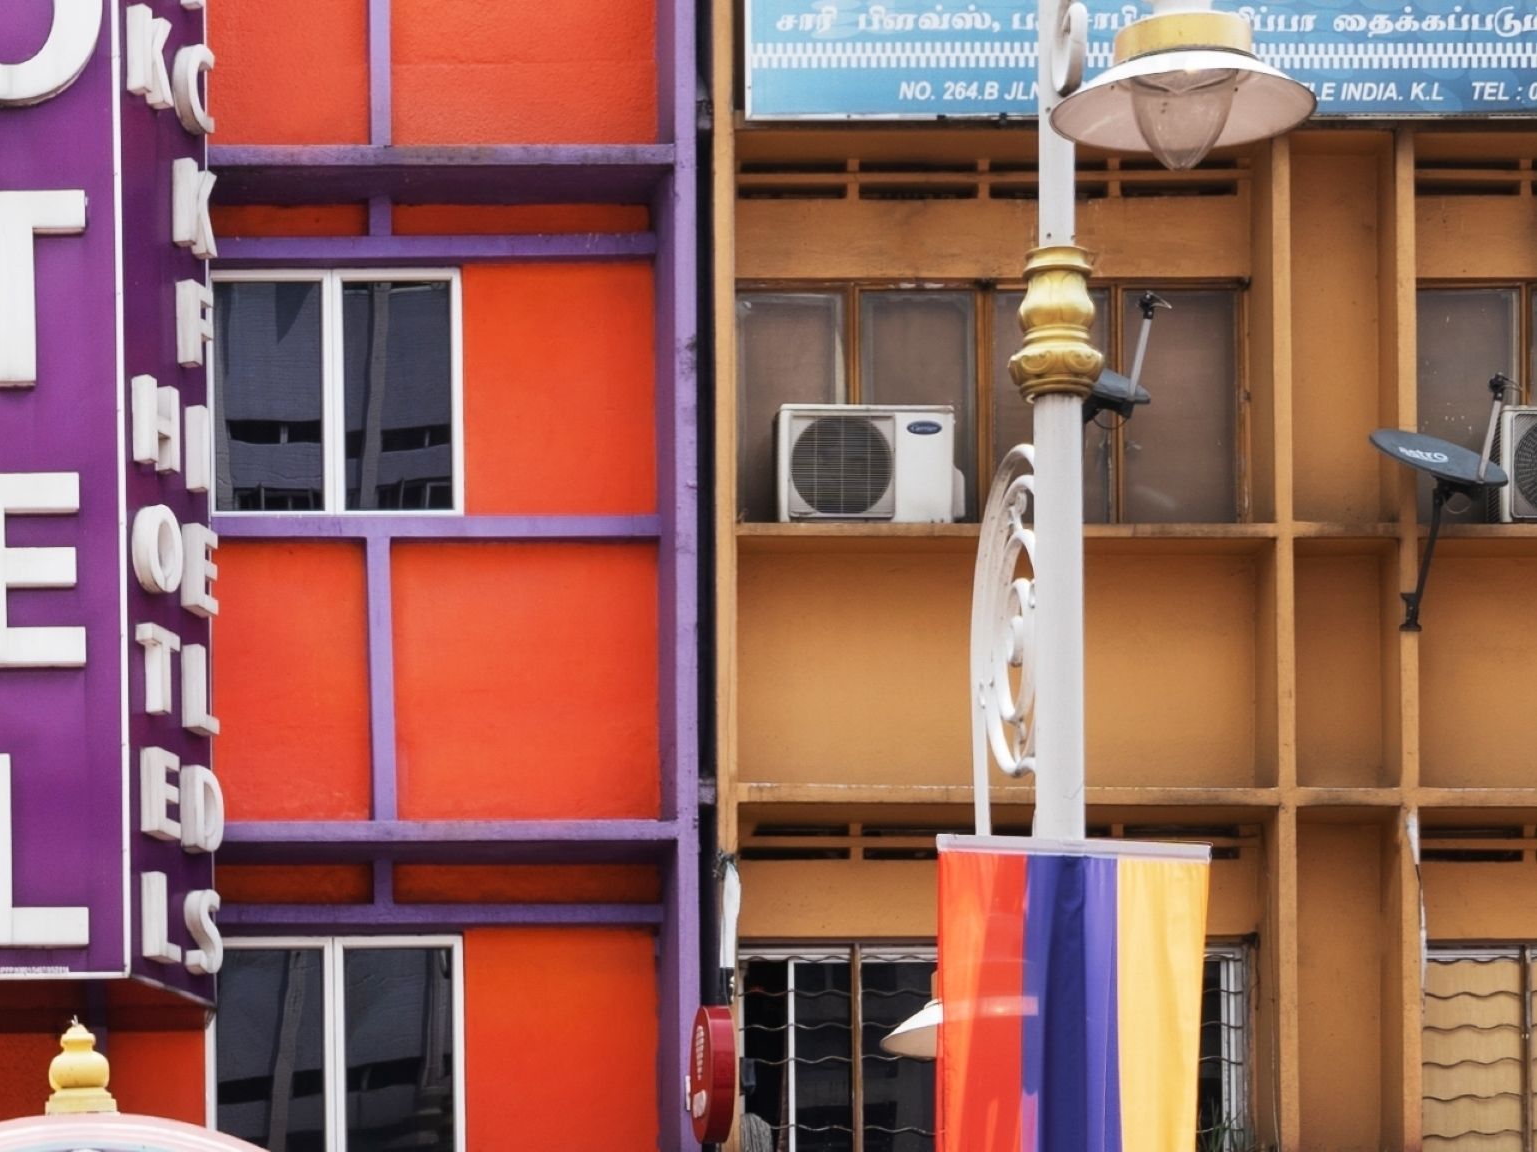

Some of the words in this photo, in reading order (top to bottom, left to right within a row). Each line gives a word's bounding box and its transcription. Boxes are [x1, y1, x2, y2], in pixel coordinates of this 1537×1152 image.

[776, 6, 838, 32] சாரி
[898, 81, 935, 100] NO.
[943, 81, 999, 101] 264.B
[1340, 81, 1404, 102] INDIA.
[1410, 81, 1444, 101] K.L
[1471, 81, 1511, 101] TEL
[1398, 447, 1448, 462] astro
[131, 374, 183, 965] HOTEL
